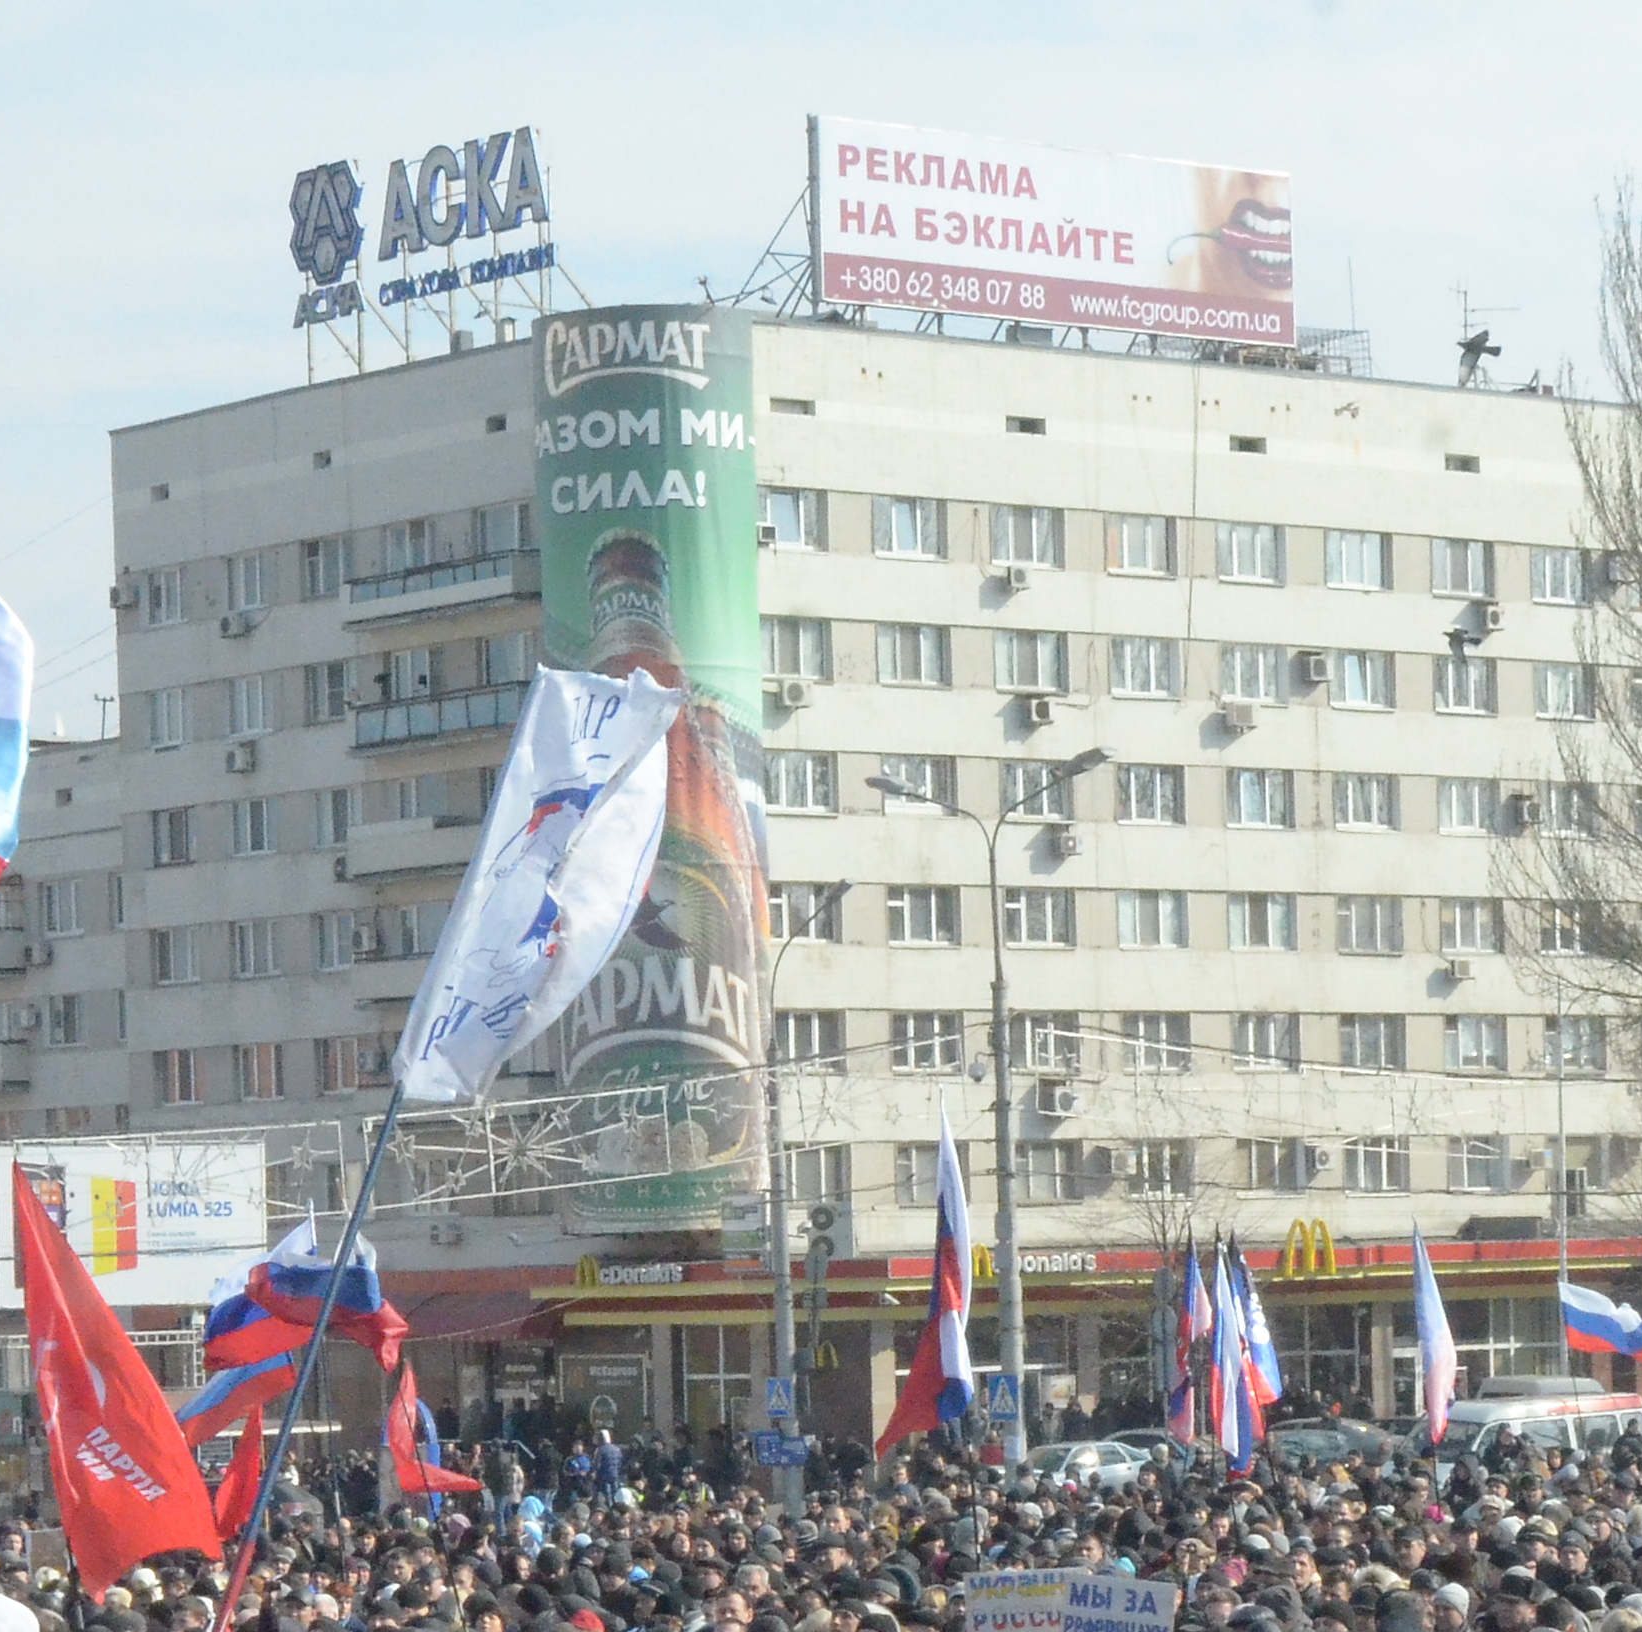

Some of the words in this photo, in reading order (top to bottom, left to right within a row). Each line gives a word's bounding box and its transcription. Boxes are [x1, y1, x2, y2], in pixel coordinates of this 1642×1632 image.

[378, 125, 549, 262] АСКА
[837, 143, 1038, 201] РЕКЛАМА
[839, 199, 897, 239] НА
[914, 208, 1136, 266] БЭКЛАЙТЕ
[840, 265, 900, 295] +380
[906, 270, 933, 299] 62
[940, 272, 980, 302] 348
[986, 278, 1013, 307] 07
[1019, 282, 1046, 310] 88
[1070, 292, 1281, 335] www.fcgroup.com.ua
[544, 320, 711, 398] САРМАТ
[535, 407, 661, 459] АЗОМ
[680, 408, 745, 451] МИ
[551, 469, 707, 515] СИЛА!
[204, 1201, 233, 1218] 525
[86, 1425, 167, 1502] ПАРТІЯ
[973, 1608, 1062, 1631] РОССИ
[1069, 1583, 1114, 1609] МЫ
[1123, 1589, 1158, 1615] ЗА
